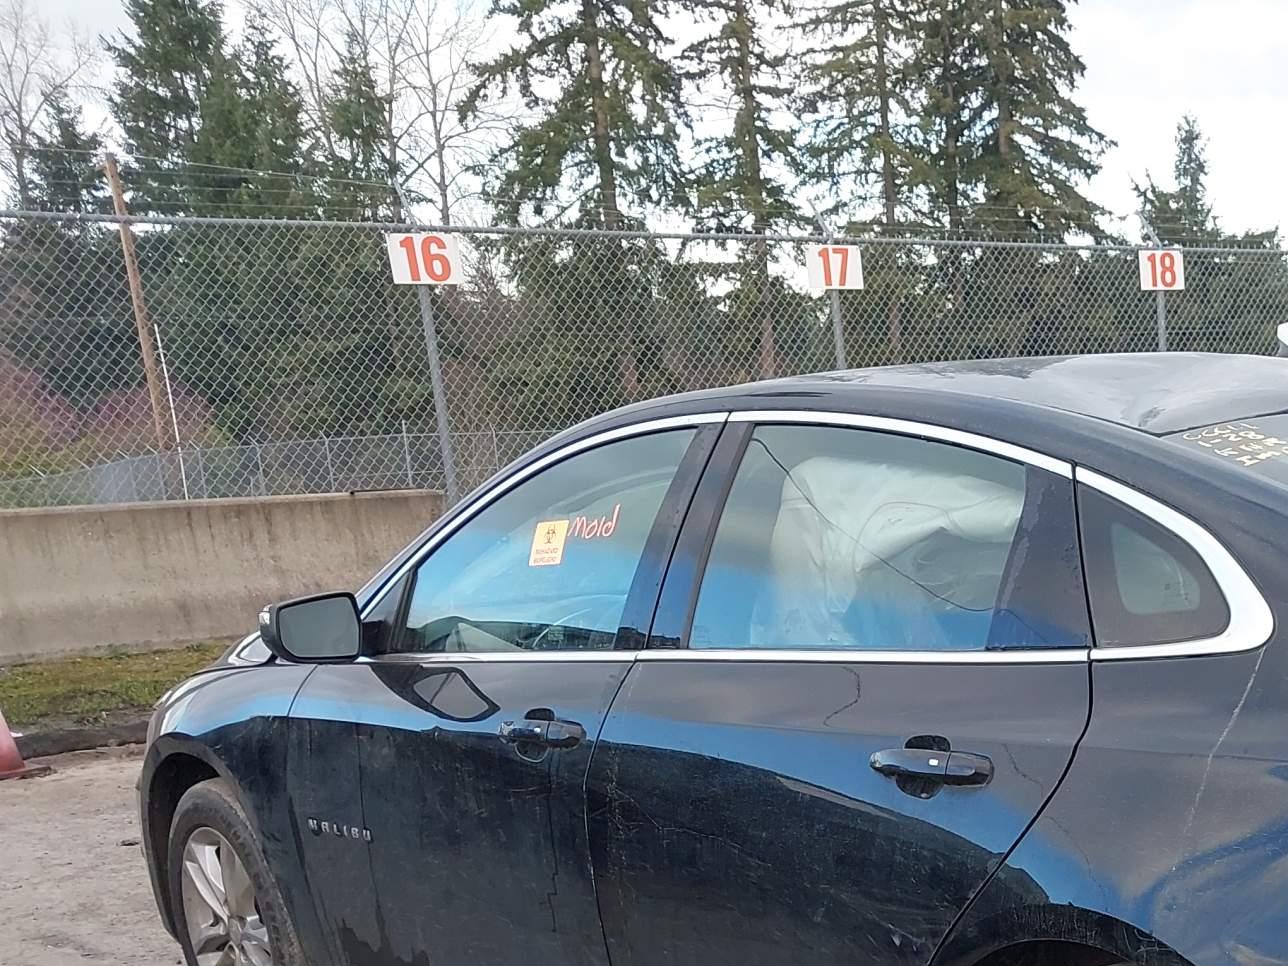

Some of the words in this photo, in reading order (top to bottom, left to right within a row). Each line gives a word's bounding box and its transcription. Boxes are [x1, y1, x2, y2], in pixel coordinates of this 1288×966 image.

[400, 235, 451, 282] 16
[818, 247, 849, 286] 17
[1147, 252, 1176, 288] 18
[308, 818, 372, 841] MALIBU
